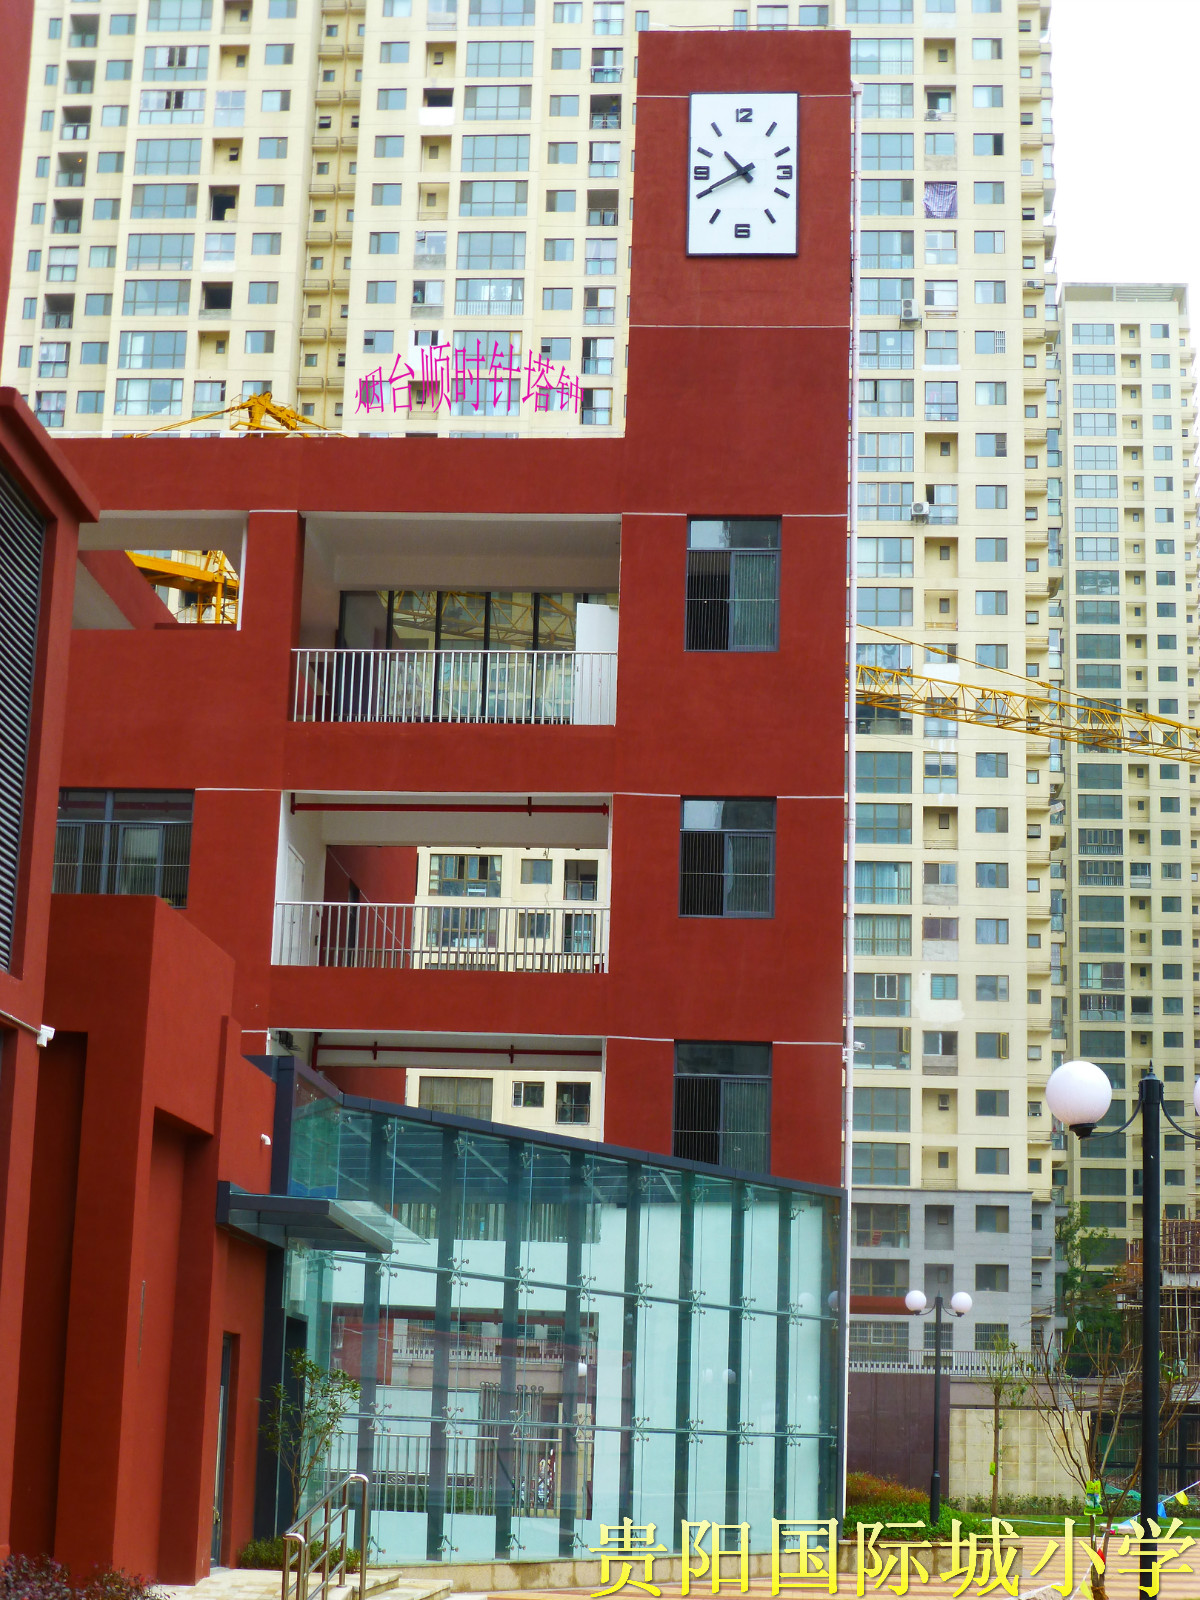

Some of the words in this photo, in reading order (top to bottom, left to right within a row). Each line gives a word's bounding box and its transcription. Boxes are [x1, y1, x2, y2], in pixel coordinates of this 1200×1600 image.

[735, 107, 753, 123] 12
[693, 165, 710, 180] 9
[776, 164, 793, 180] 3
[734, 223, 751, 239] 6
